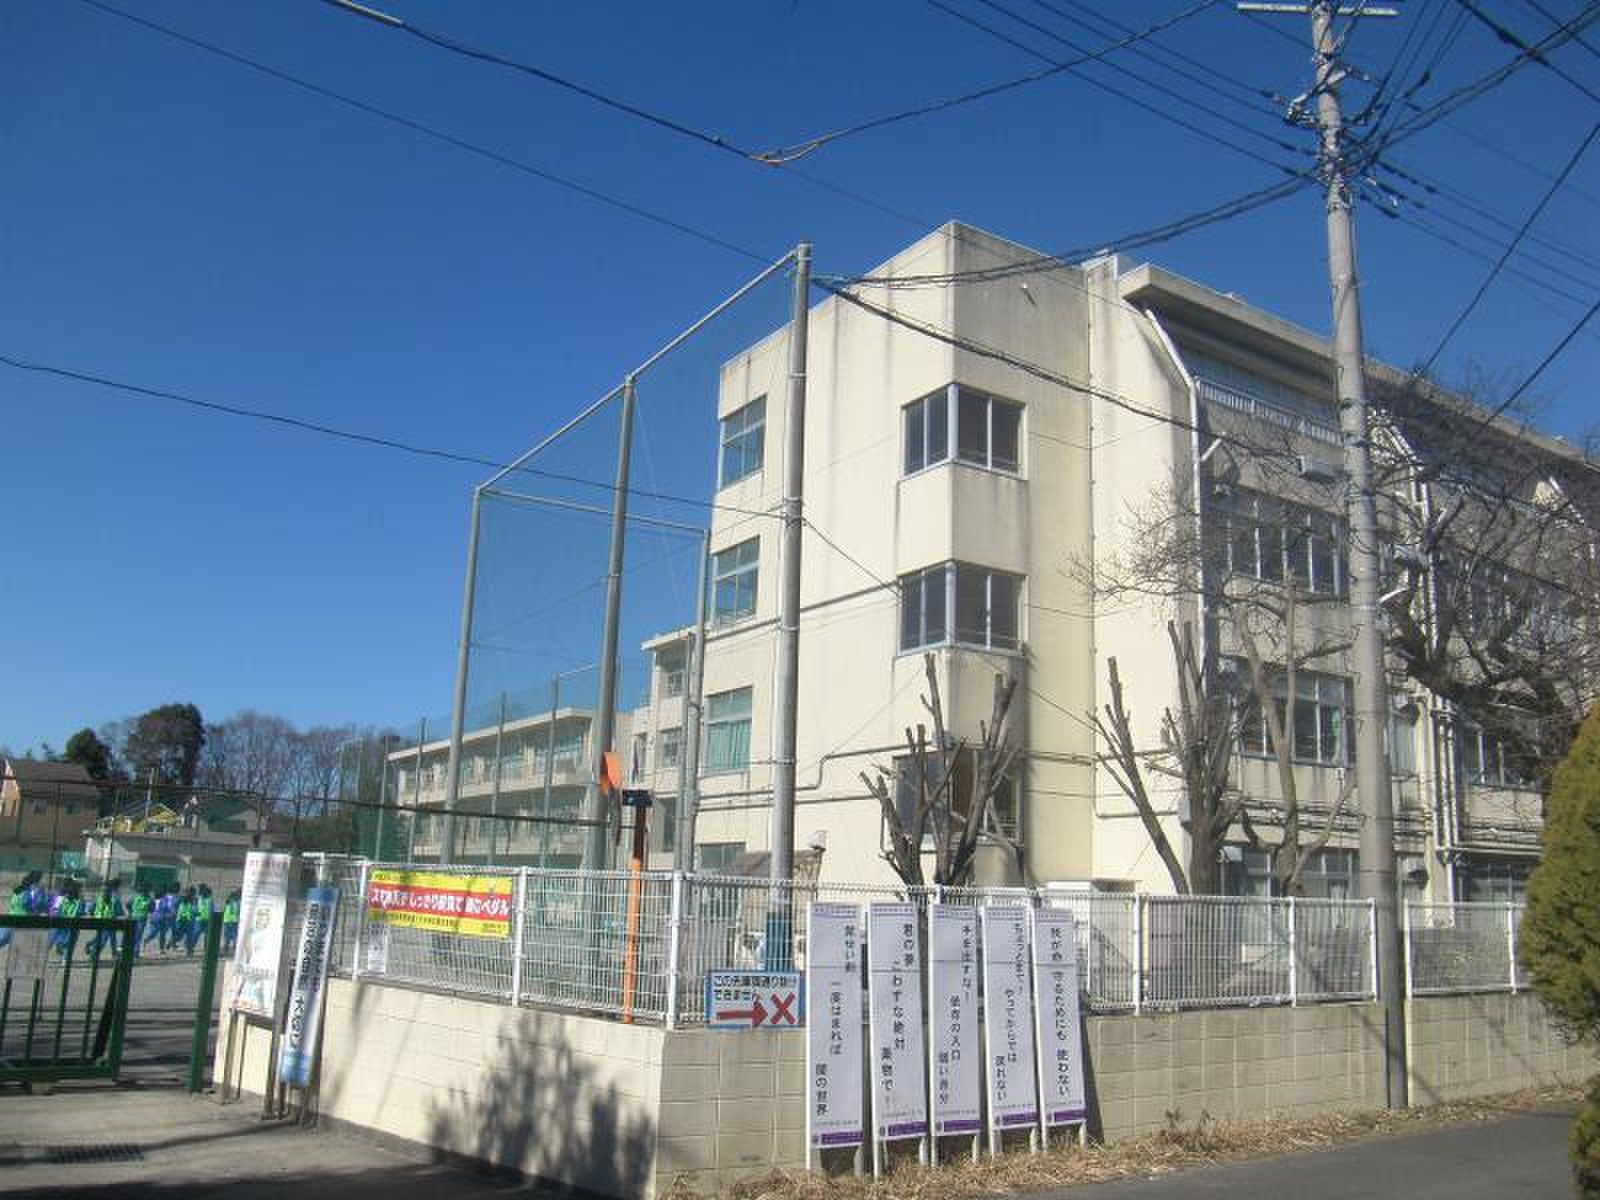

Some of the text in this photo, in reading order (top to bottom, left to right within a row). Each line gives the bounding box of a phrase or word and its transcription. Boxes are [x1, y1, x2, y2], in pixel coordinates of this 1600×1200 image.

[904, 924, 915, 967] 君の夢
[831, 981, 843, 1055] 一度はまれば
[892, 961, 905, 1049] こわすな絶対
[1056, 1050, 1071, 1097] 使わない
